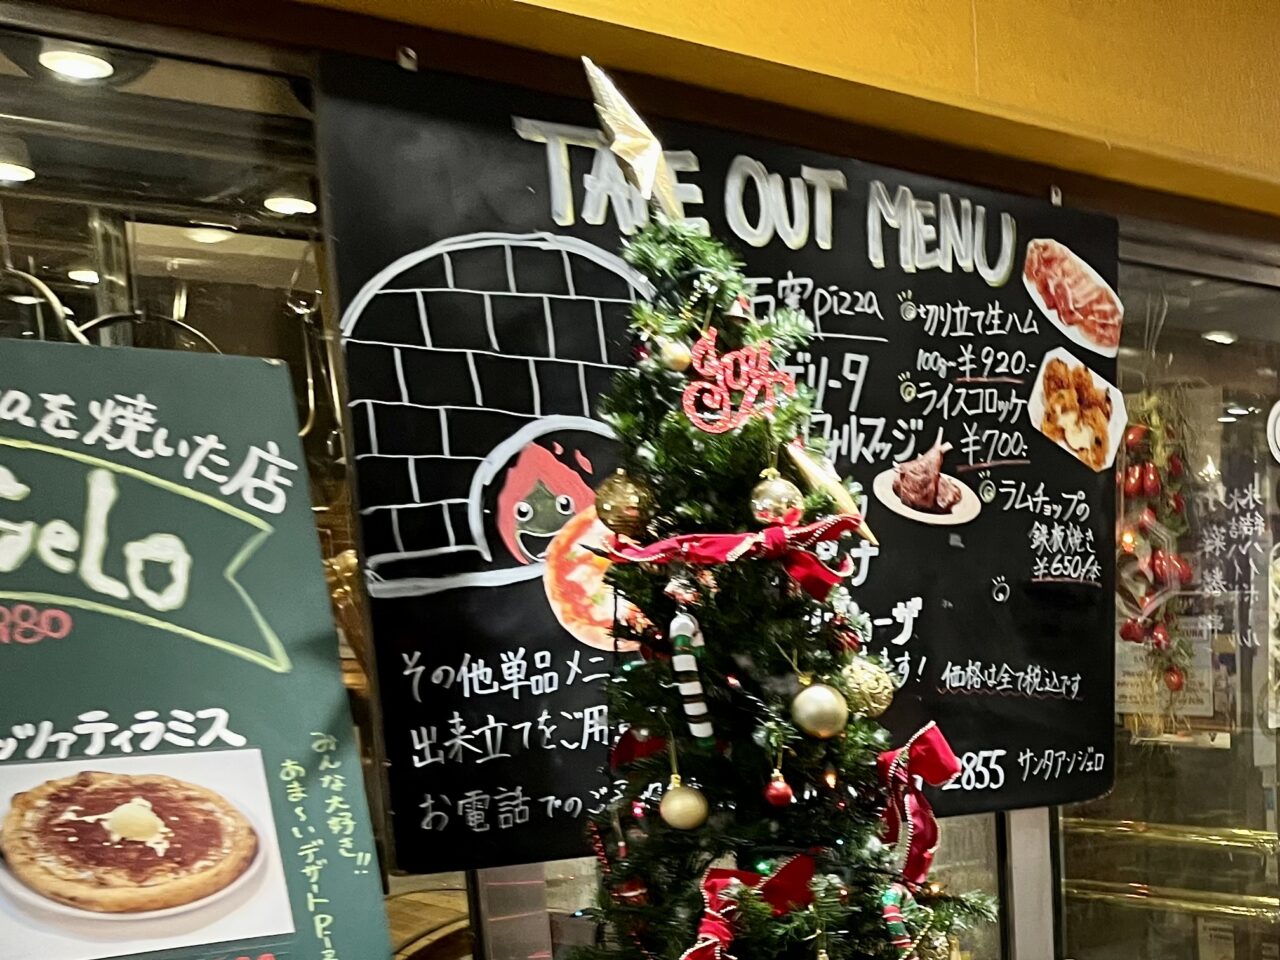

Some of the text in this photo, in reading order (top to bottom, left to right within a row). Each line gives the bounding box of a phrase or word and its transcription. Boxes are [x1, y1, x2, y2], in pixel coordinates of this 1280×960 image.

[724, 155, 848, 251] OUT
[866, 178, 1018, 288] MENU
[916, 382, 1029, 424] ライスコロッケ
[998, 481, 1091, 522] ラムチョップの
[941, 659, 1082, 700] 価格は全て税込です
